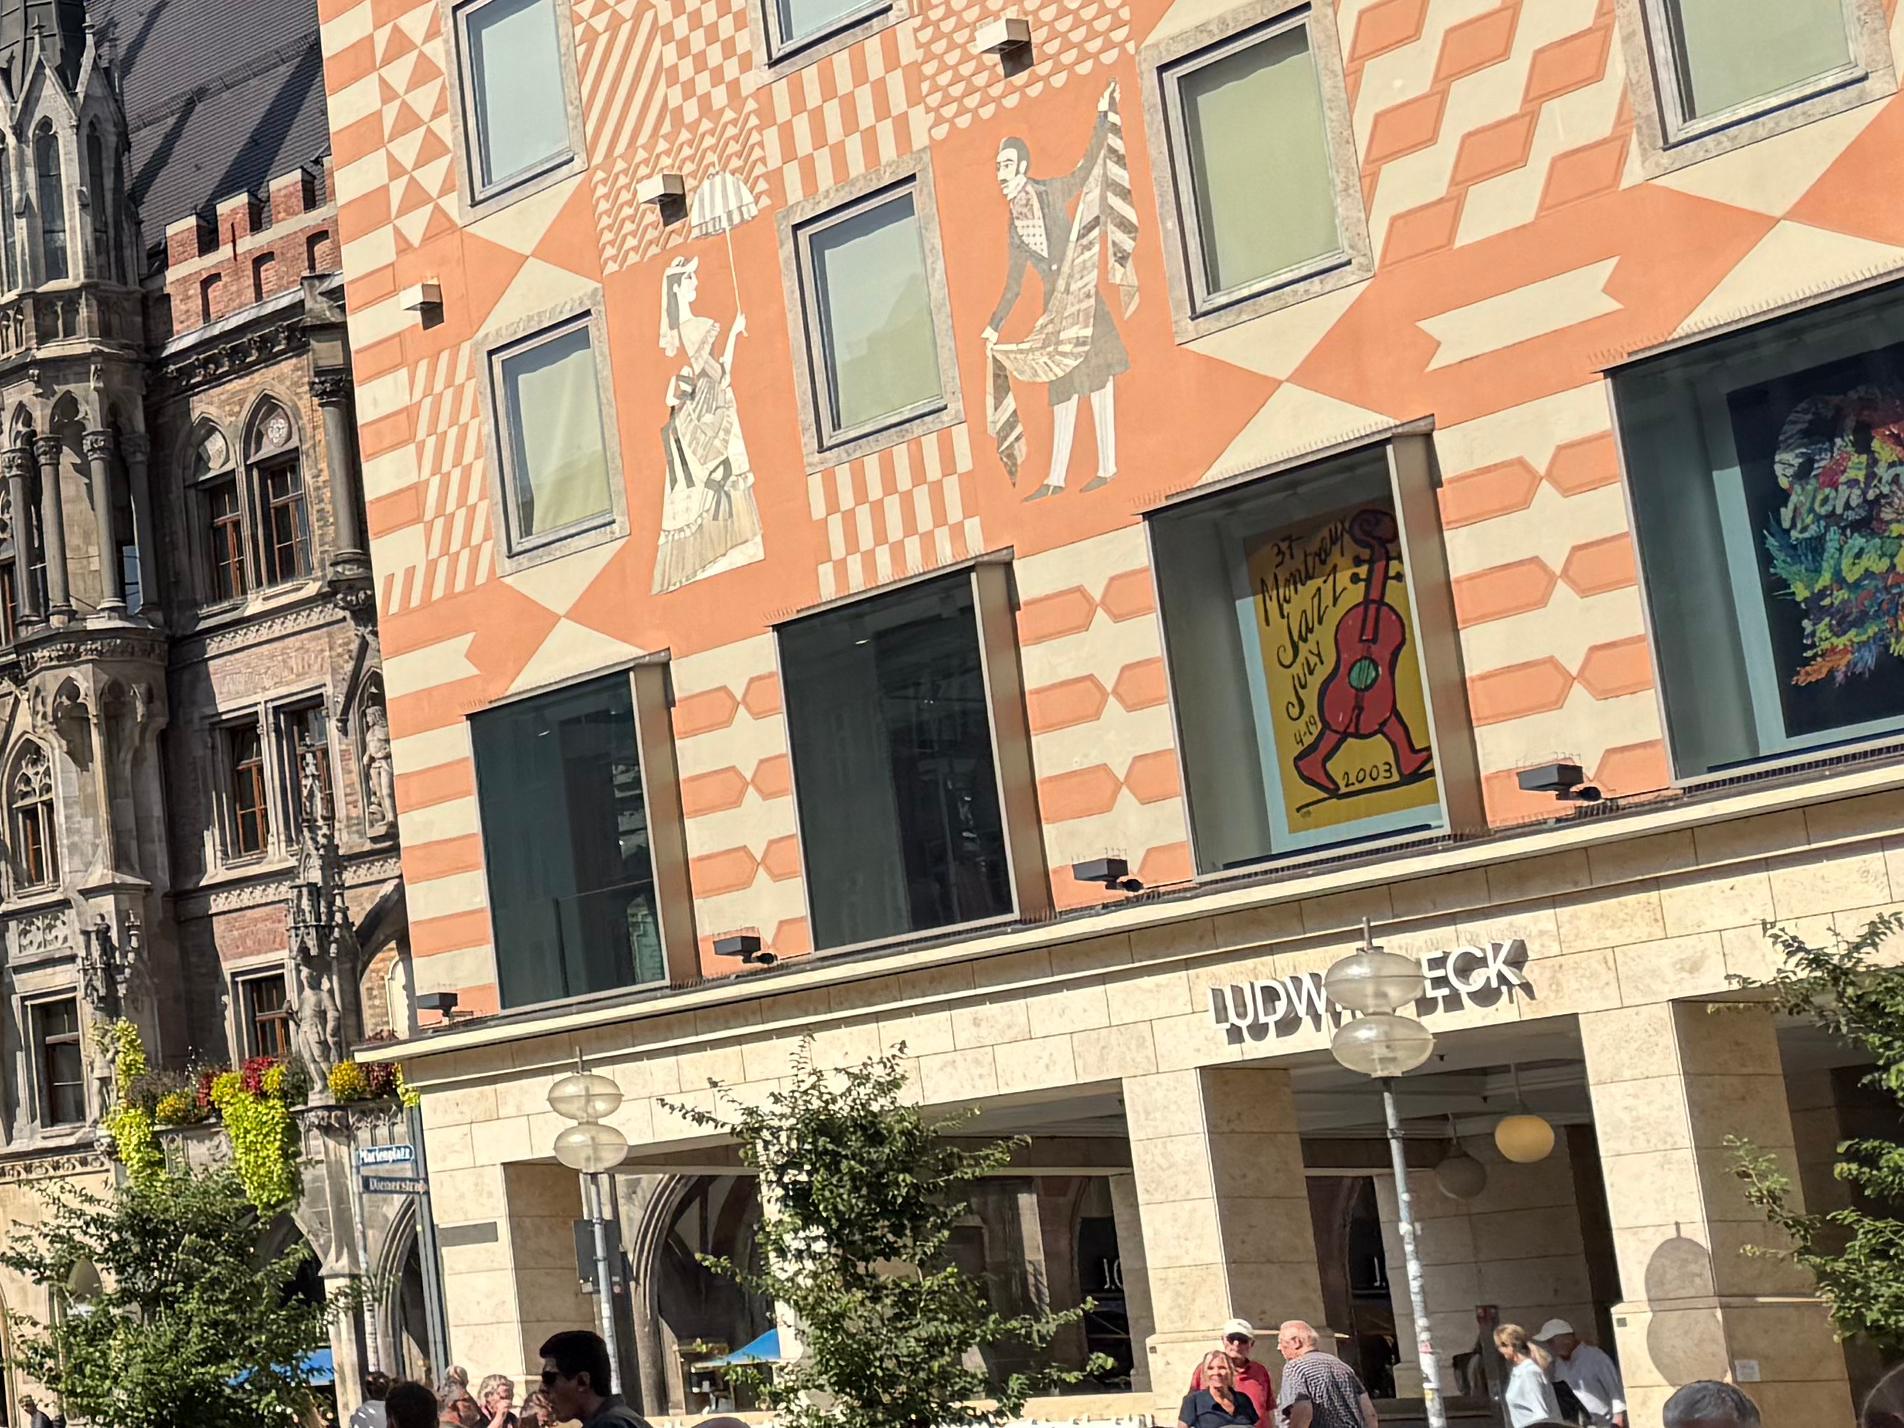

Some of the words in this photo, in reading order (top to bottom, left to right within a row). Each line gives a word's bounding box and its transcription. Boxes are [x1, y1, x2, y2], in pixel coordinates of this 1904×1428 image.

[1260, 519, 1349, 627] Montreux
[1271, 535, 1304, 568] 37
[1277, 563, 1347, 669] Jazz
[1341, 761, 1394, 789] 2003
[1420, 938, 1522, 998] ECK
